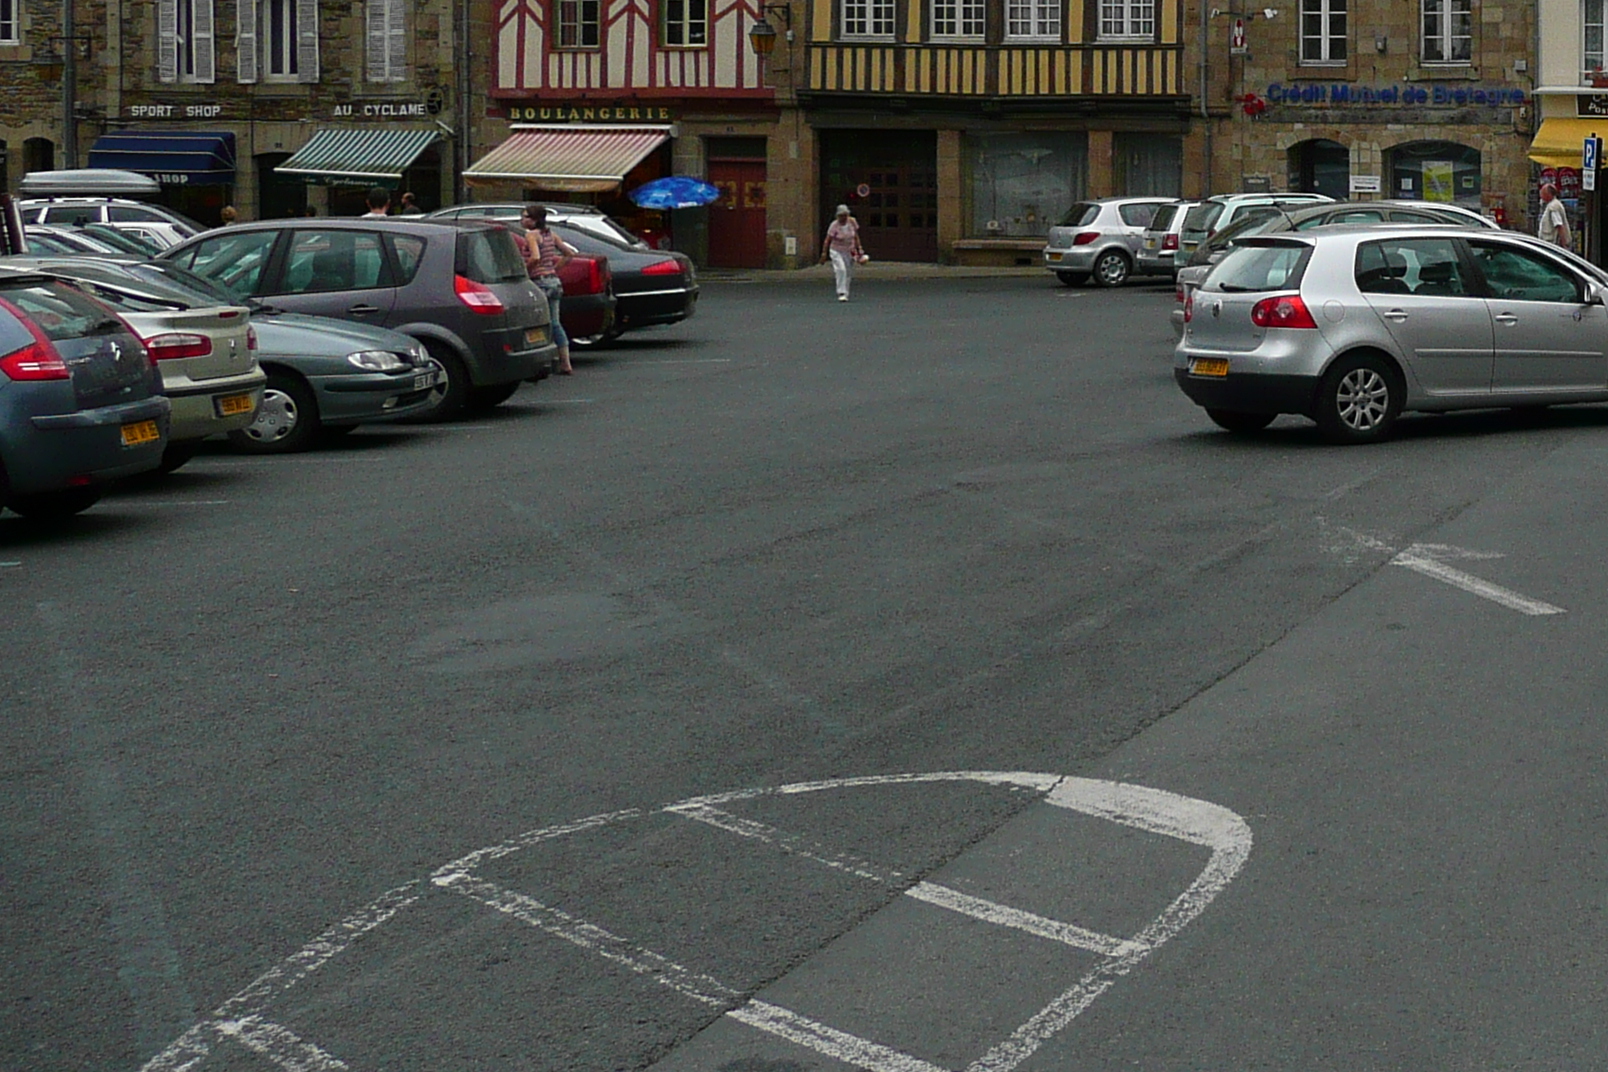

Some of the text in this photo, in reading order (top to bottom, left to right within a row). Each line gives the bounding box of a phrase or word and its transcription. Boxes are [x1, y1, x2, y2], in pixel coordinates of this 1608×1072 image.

[1267, 82, 1525, 106] Crédit Mutuel de Bretagne
[131, 105, 221, 117] SPORT SHOP
[334, 105, 352, 116] AU
[510, 107, 670, 120] BOULANGERIE
[1586, 143, 1593, 164] P
